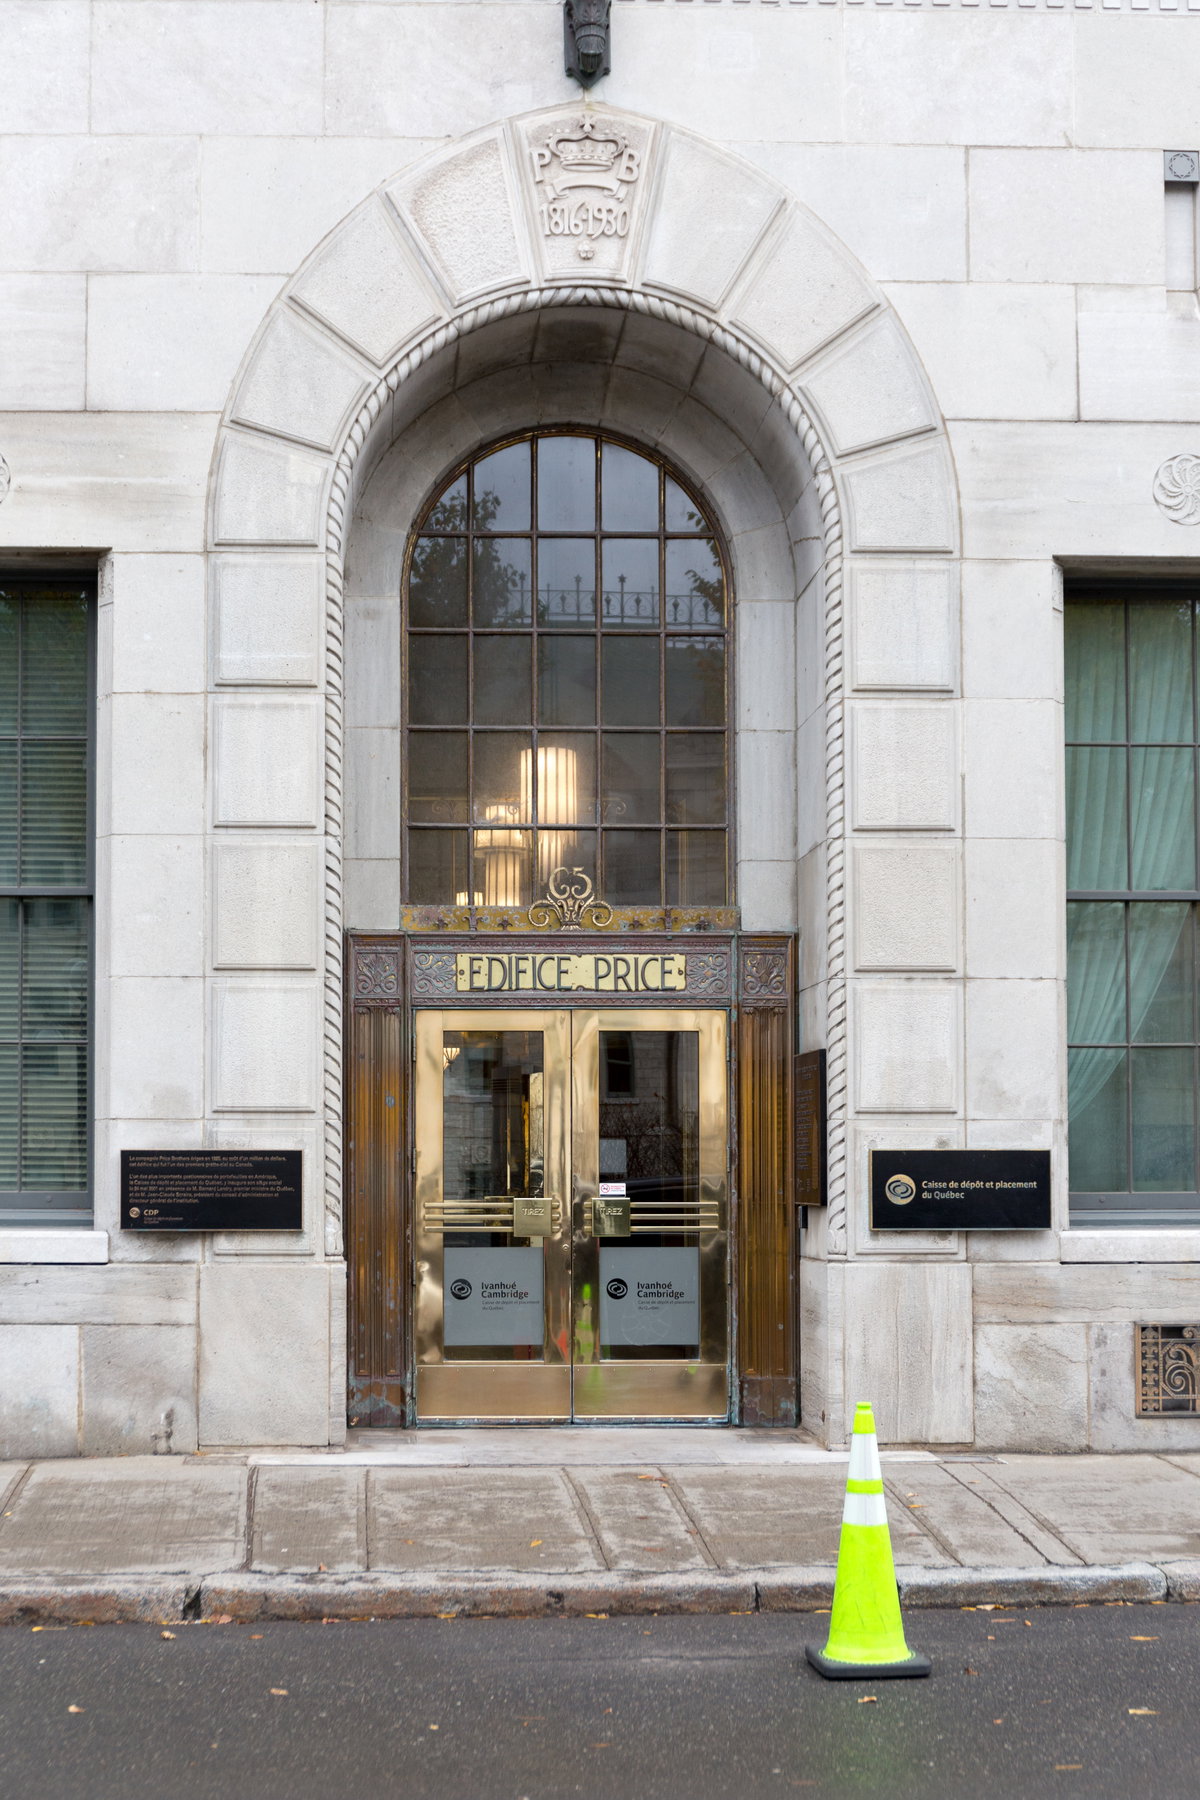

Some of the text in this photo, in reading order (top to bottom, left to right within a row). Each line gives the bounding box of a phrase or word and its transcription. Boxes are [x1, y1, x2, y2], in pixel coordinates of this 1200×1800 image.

[531, 147, 641, 183] P B
[541, 201, 629, 240] 1816-1930
[469, 956, 677, 991] EDIFICE PRICE
[922, 1180, 1037, 1190] Caisse de dépôt et placement
[922, 1191, 965, 1200] du Québec
[521, 1208, 545, 1216] TIREZ
[481, 1281, 517, 1289] Ivanhoé
[637, 1281, 673, 1289] Ivanhoé
[481, 1290, 529, 1299] Cambridge
[637, 1290, 685, 1299] Cambridge
